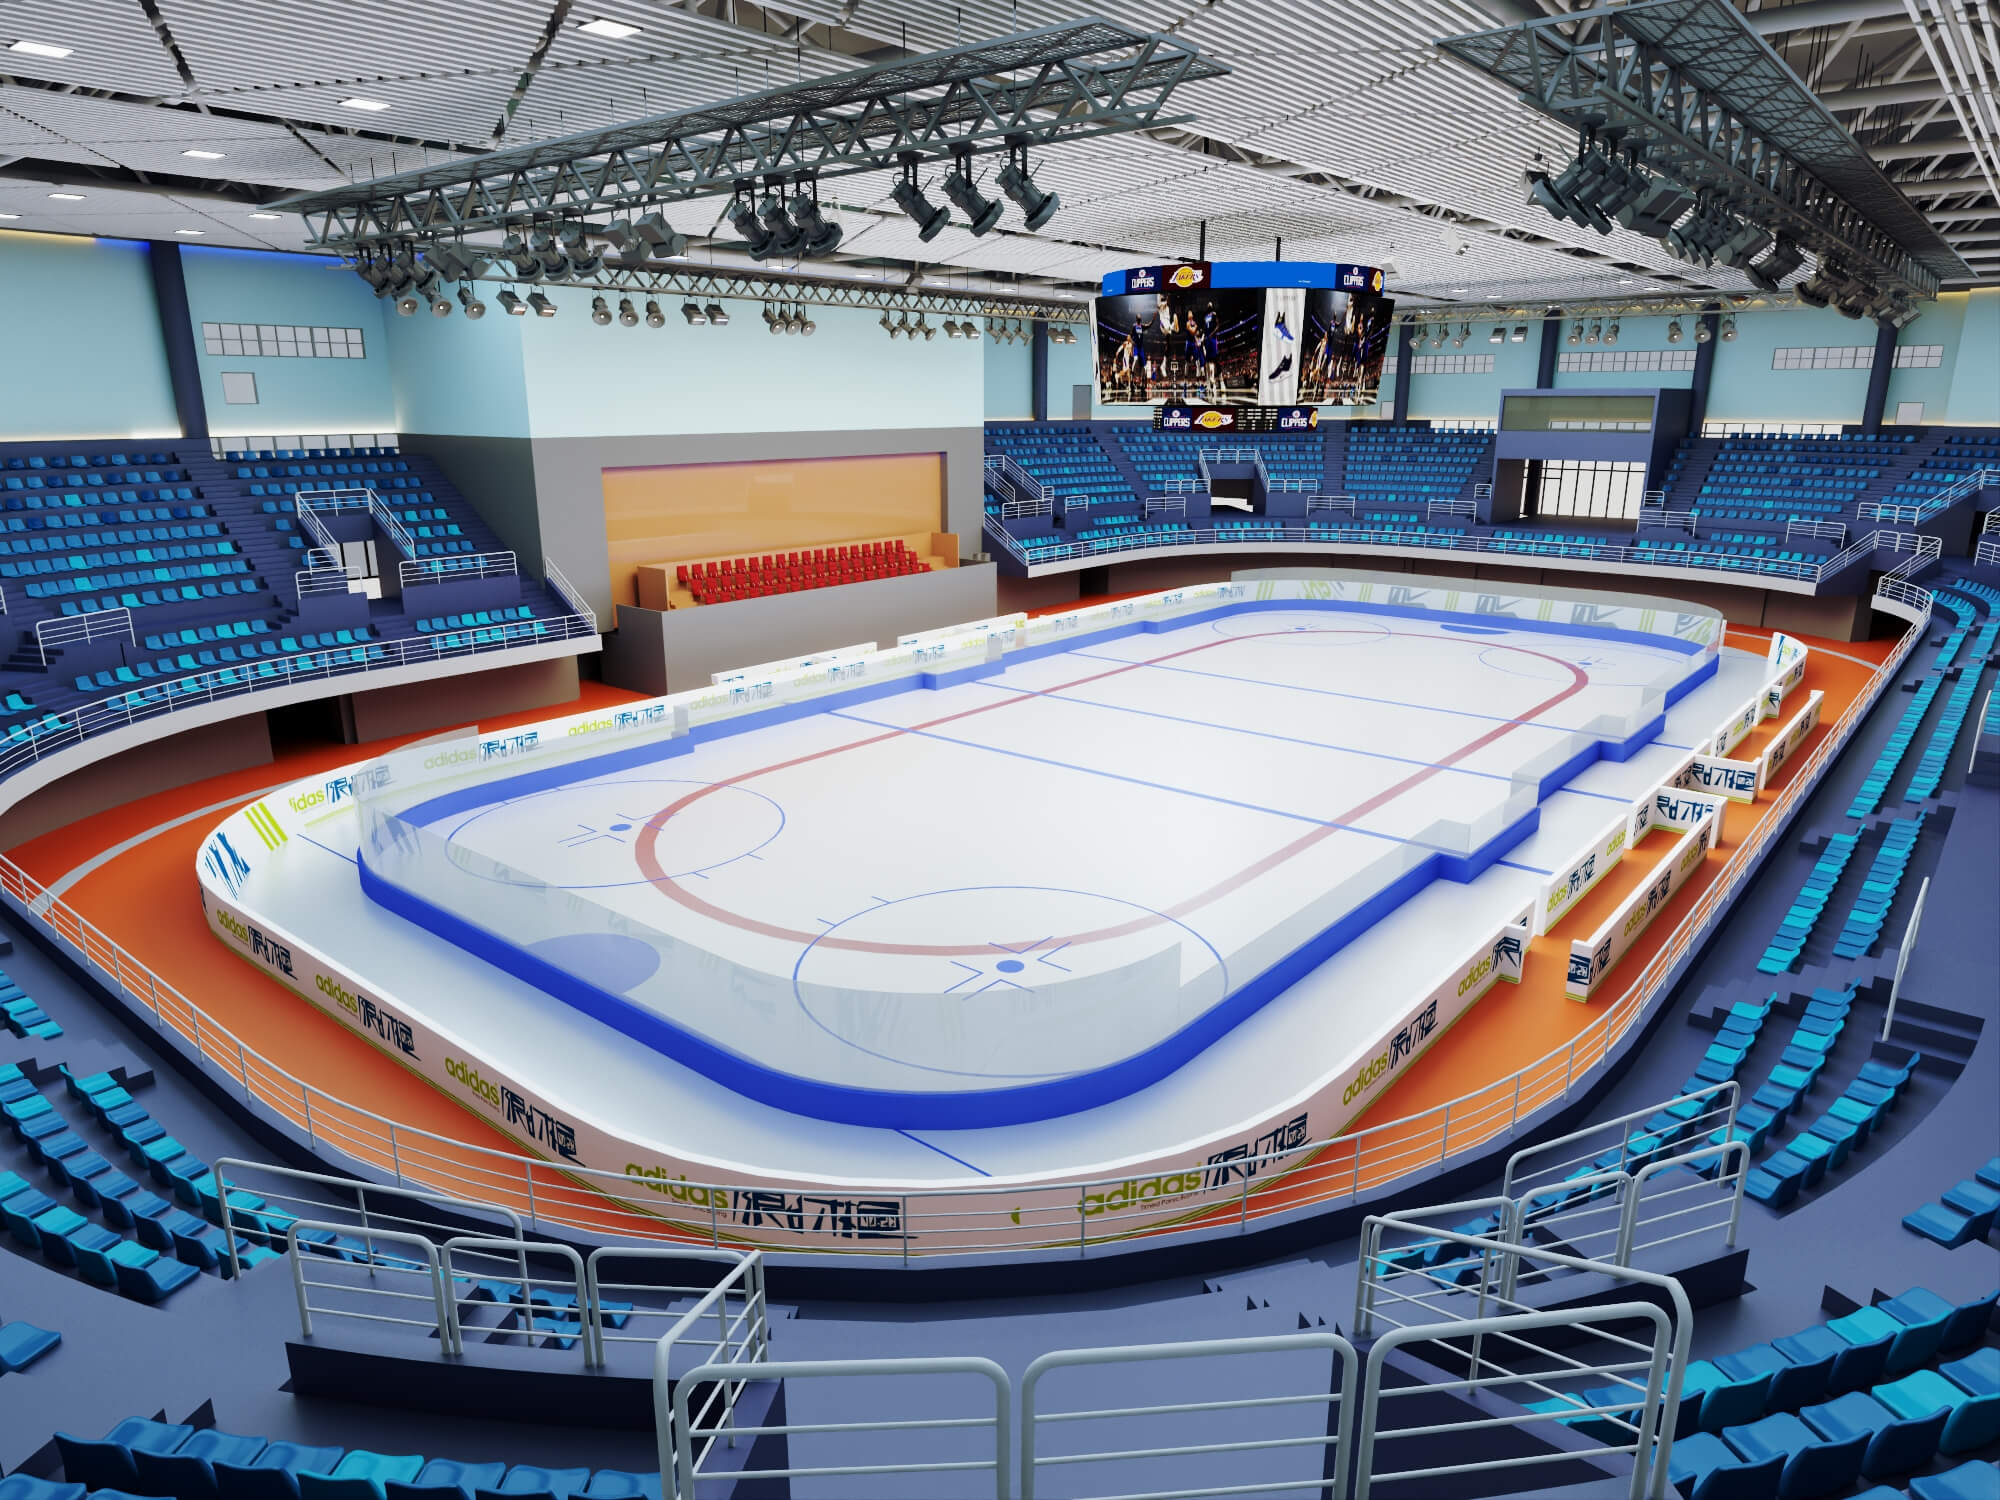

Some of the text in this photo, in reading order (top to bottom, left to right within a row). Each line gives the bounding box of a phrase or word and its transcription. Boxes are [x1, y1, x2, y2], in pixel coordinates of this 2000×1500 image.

[1131, 276, 1155, 289] CLIPPERS
[1169, 269, 1204, 284] LAKERS
[1343, 274, 1364, 287] CLIPPERS
[1163, 416, 1191, 428] CLIPPERS
[1194, 414, 1234, 426] LAKERS
[1280, 416, 1308, 428] CLIPPERS
[568, 717, 614, 738] adidas
[424, 750, 477, 771] adidas
[216, 909, 249, 943] adidas
[1457, 954, 1491, 997] adidas
[315, 974, 358, 1013] adidas
[445, 1056, 500, 1106] adidas
[1342, 1050, 1388, 1106] adidas
[625, 1162, 729, 1210] adidas
[1077, 1167, 1202, 1217] adidas
